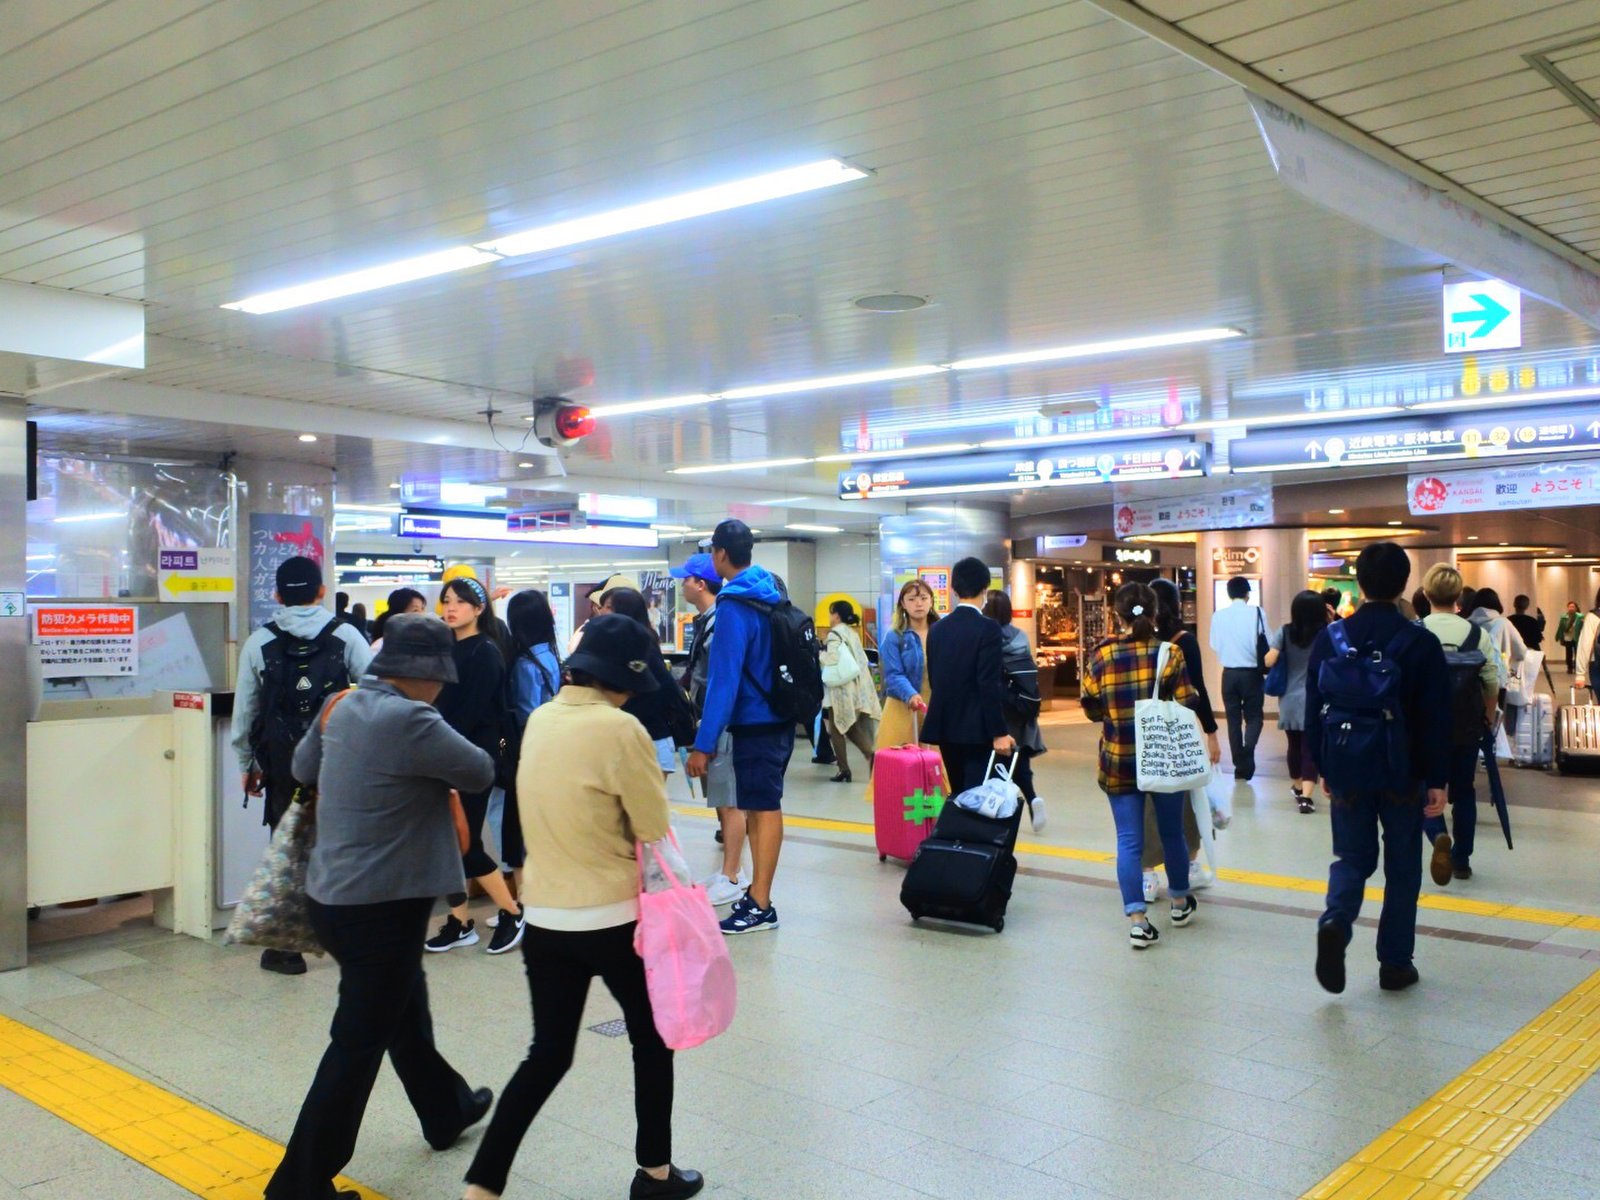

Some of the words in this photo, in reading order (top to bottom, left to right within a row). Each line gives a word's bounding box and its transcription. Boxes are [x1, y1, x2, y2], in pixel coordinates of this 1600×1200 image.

[161, 556, 196, 567] 라피트
[41, 613, 130, 625] 防犯カメラ作動中
[1141, 751, 1165, 759] Osaka
[1185, 749, 1204, 758] Cruz
[1141, 759, 1170, 769] Calgary
[1141, 768, 1169, 777] Seattle
[1170, 765, 1204, 778] Cleveland
